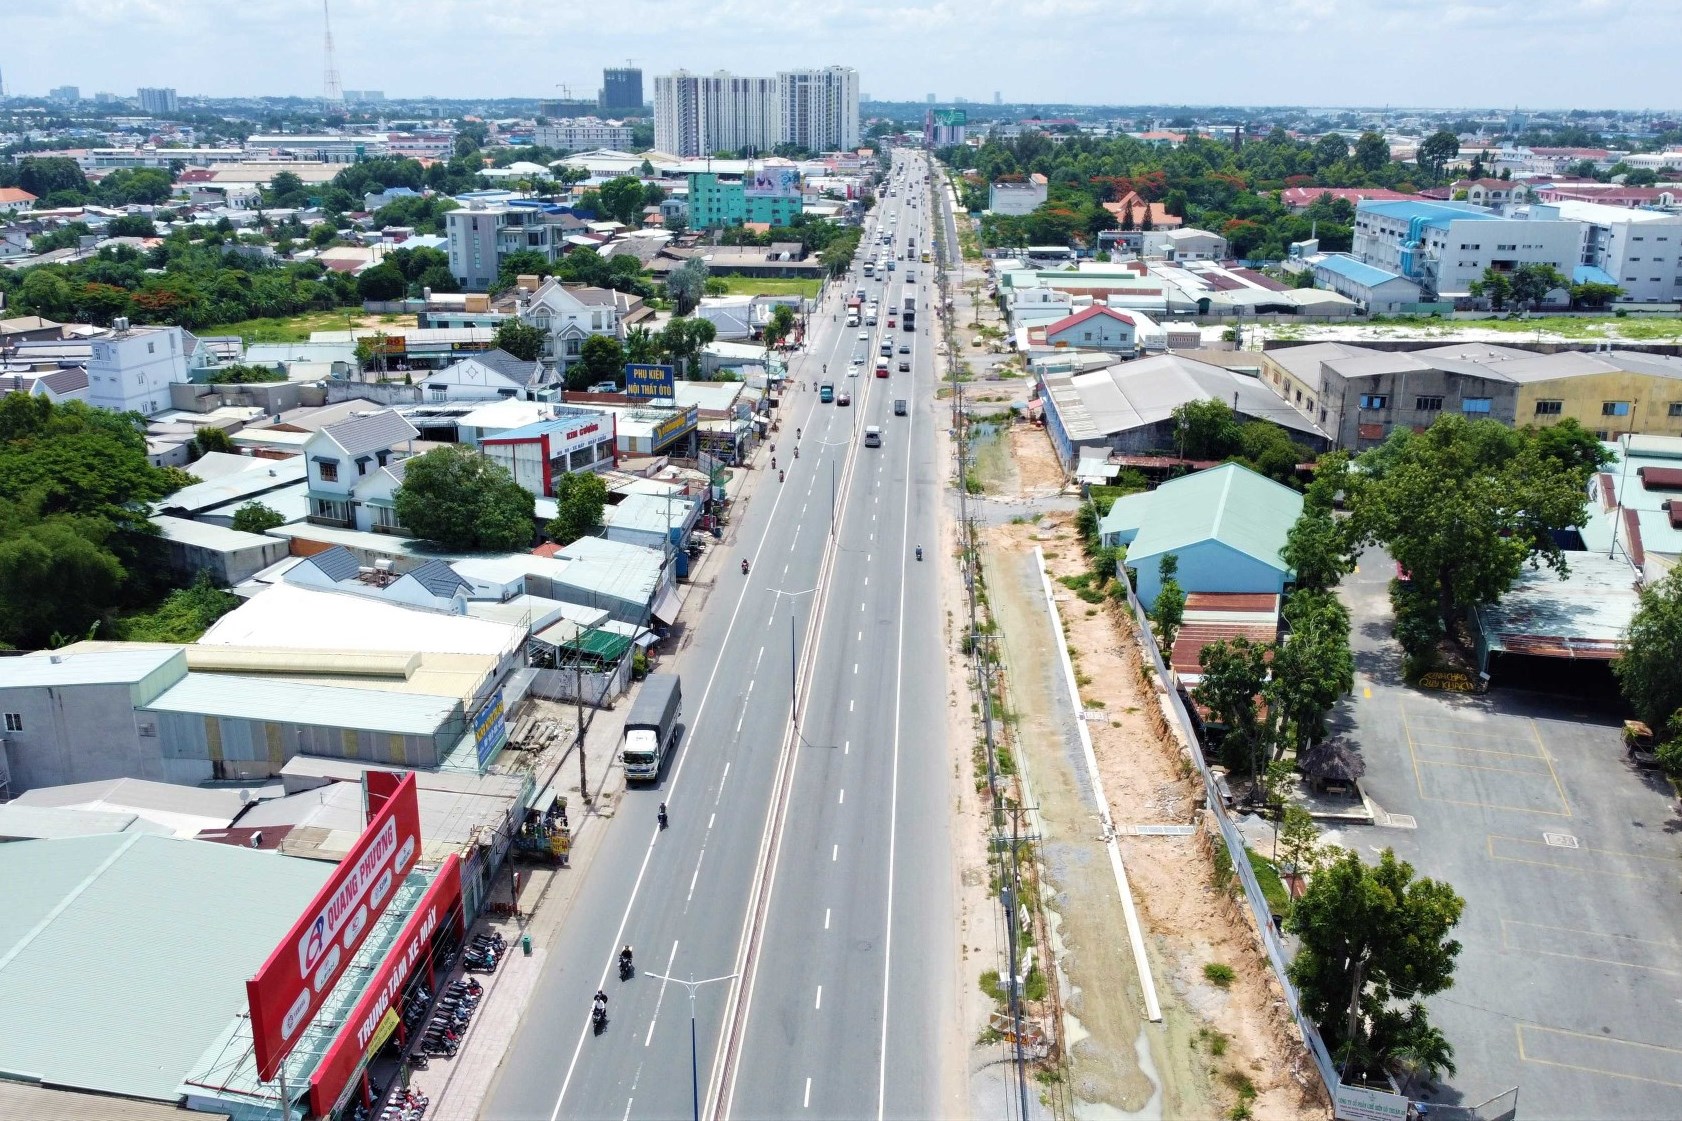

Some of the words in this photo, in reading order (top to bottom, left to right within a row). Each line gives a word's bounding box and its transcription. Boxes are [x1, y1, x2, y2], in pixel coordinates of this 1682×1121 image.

[628, 382, 640, 396] NỘI
[640, 381, 657, 396] THẤT
[633, 368, 648, 381] PHỤ
[648, 367, 665, 382] KIỆN
[327, 873, 359, 932] QUANG
[359, 824, 393, 887] PHƯƠNG
[357, 988, 389, 1050] TRUNG
[388, 956, 408, 998] TÂM
[407, 931, 419, 966] XE
[419, 903, 437, 947] MÁY
